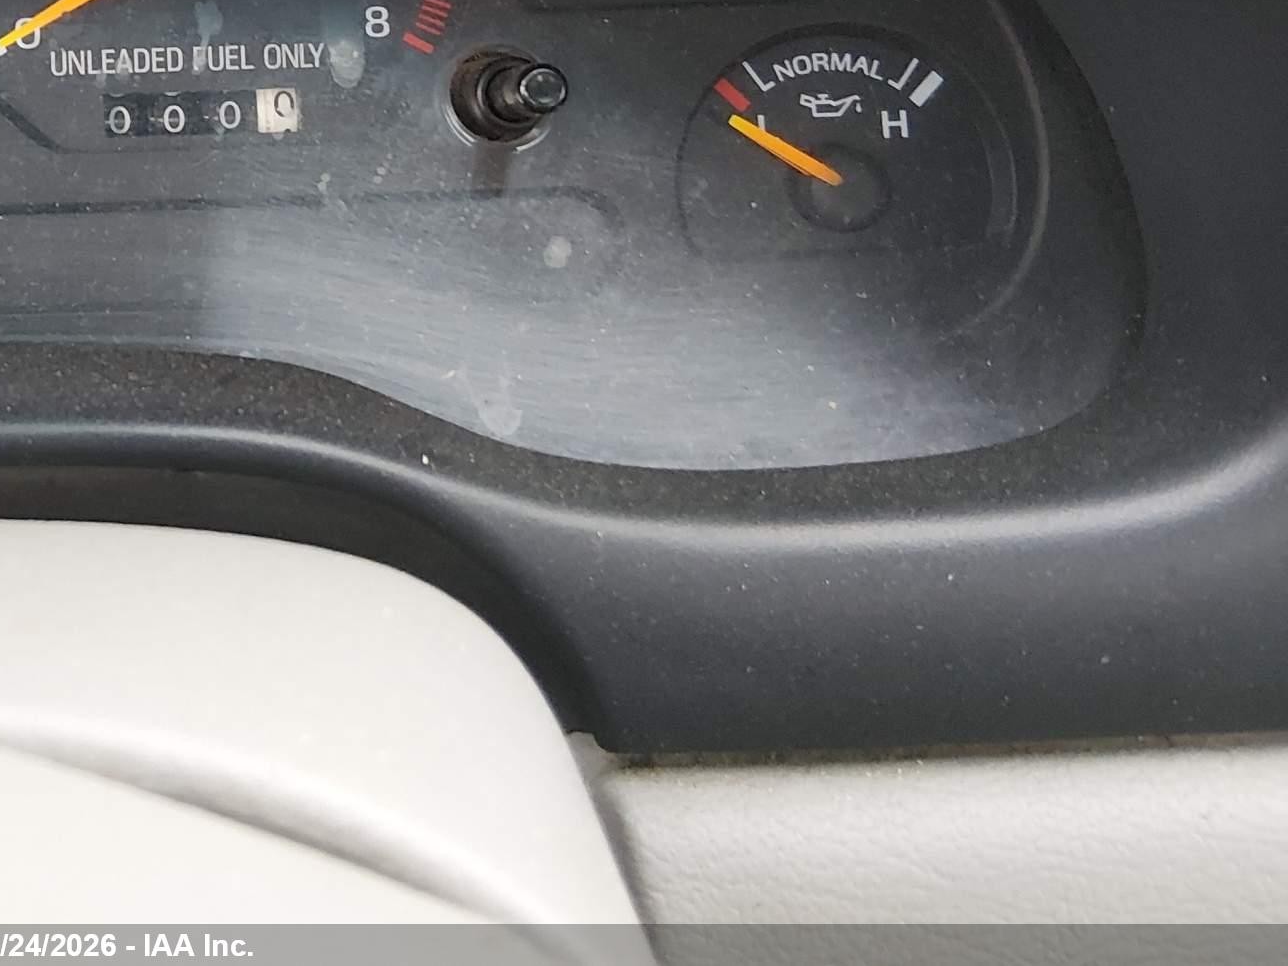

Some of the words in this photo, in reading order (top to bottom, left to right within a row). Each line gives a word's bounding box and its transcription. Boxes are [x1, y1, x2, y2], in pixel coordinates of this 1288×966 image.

[15, 17, 41, 50] 0
[366, 6, 390, 37] 8
[51, 47, 183, 76] UNLEADED
[193, 45, 254, 71] FUEL
[264, 43, 324, 69] ONLY
[773, 53, 882, 81] NORMAL
[881, 110, 908, 138] H
